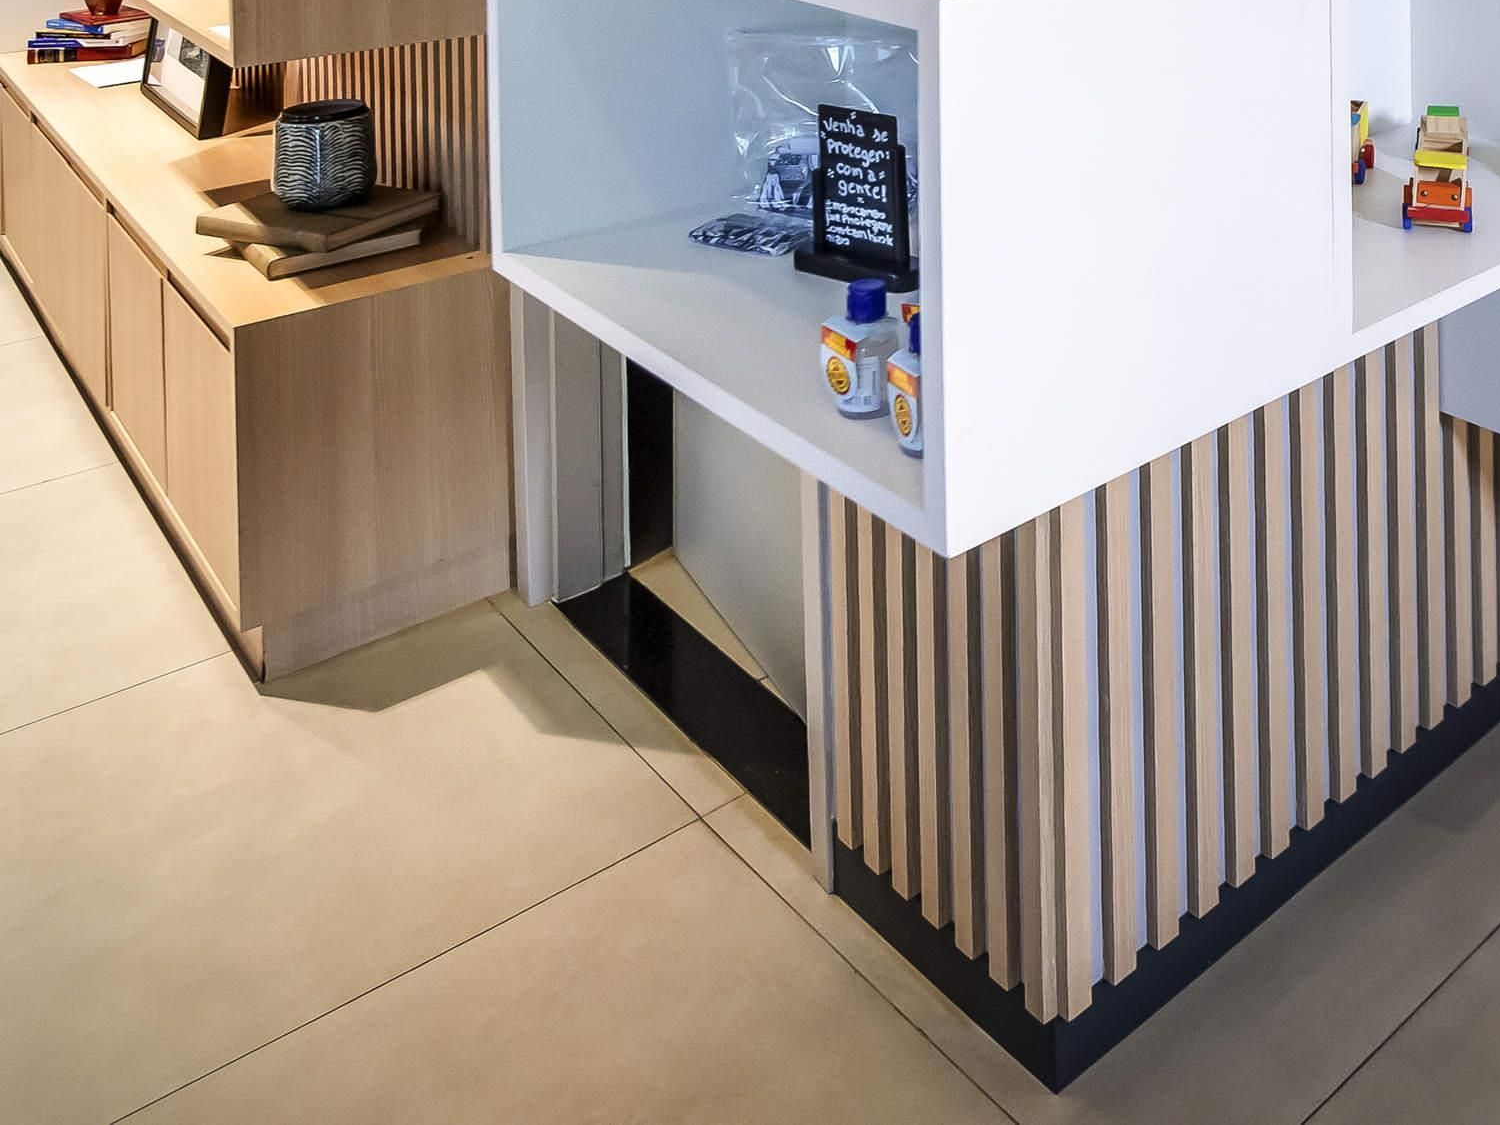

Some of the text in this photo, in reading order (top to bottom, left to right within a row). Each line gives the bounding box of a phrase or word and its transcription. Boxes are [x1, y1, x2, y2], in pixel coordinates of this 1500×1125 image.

[822, 117, 889, 143] Venha se
[836, 162, 877, 183] com a
[838, 179, 887, 203] gente!
